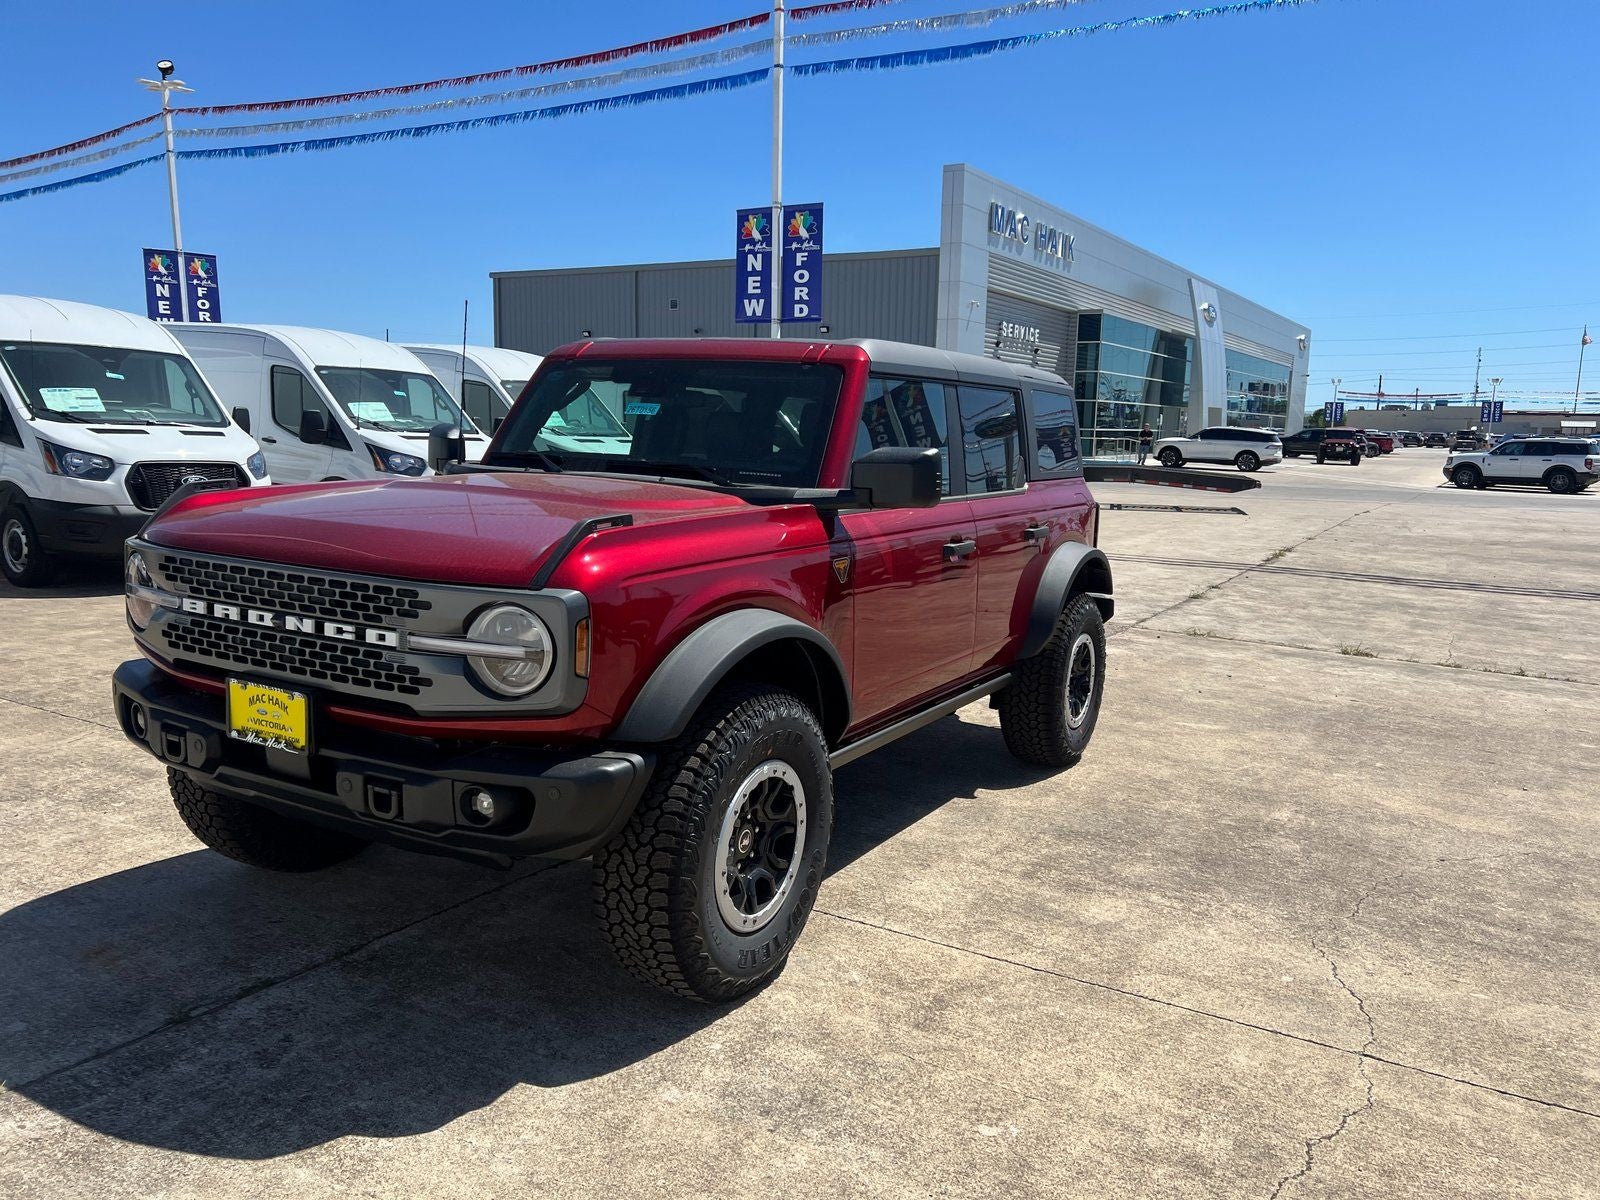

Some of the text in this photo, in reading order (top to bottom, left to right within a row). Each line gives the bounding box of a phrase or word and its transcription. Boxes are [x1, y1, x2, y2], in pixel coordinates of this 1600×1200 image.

[990, 202, 1076, 262] MAC HAIK
[743, 253, 765, 317] NEW
[793, 252, 810, 318] FORD
[1001, 321, 1040, 344] SERVICE
[182, 598, 399, 647] BRONCO
[248, 693, 266, 708] MAC
[267, 694, 290, 716] HAIK
[245, 732, 292, 751] Mac Haik
[253, 717, 287, 732] VICTORIA
